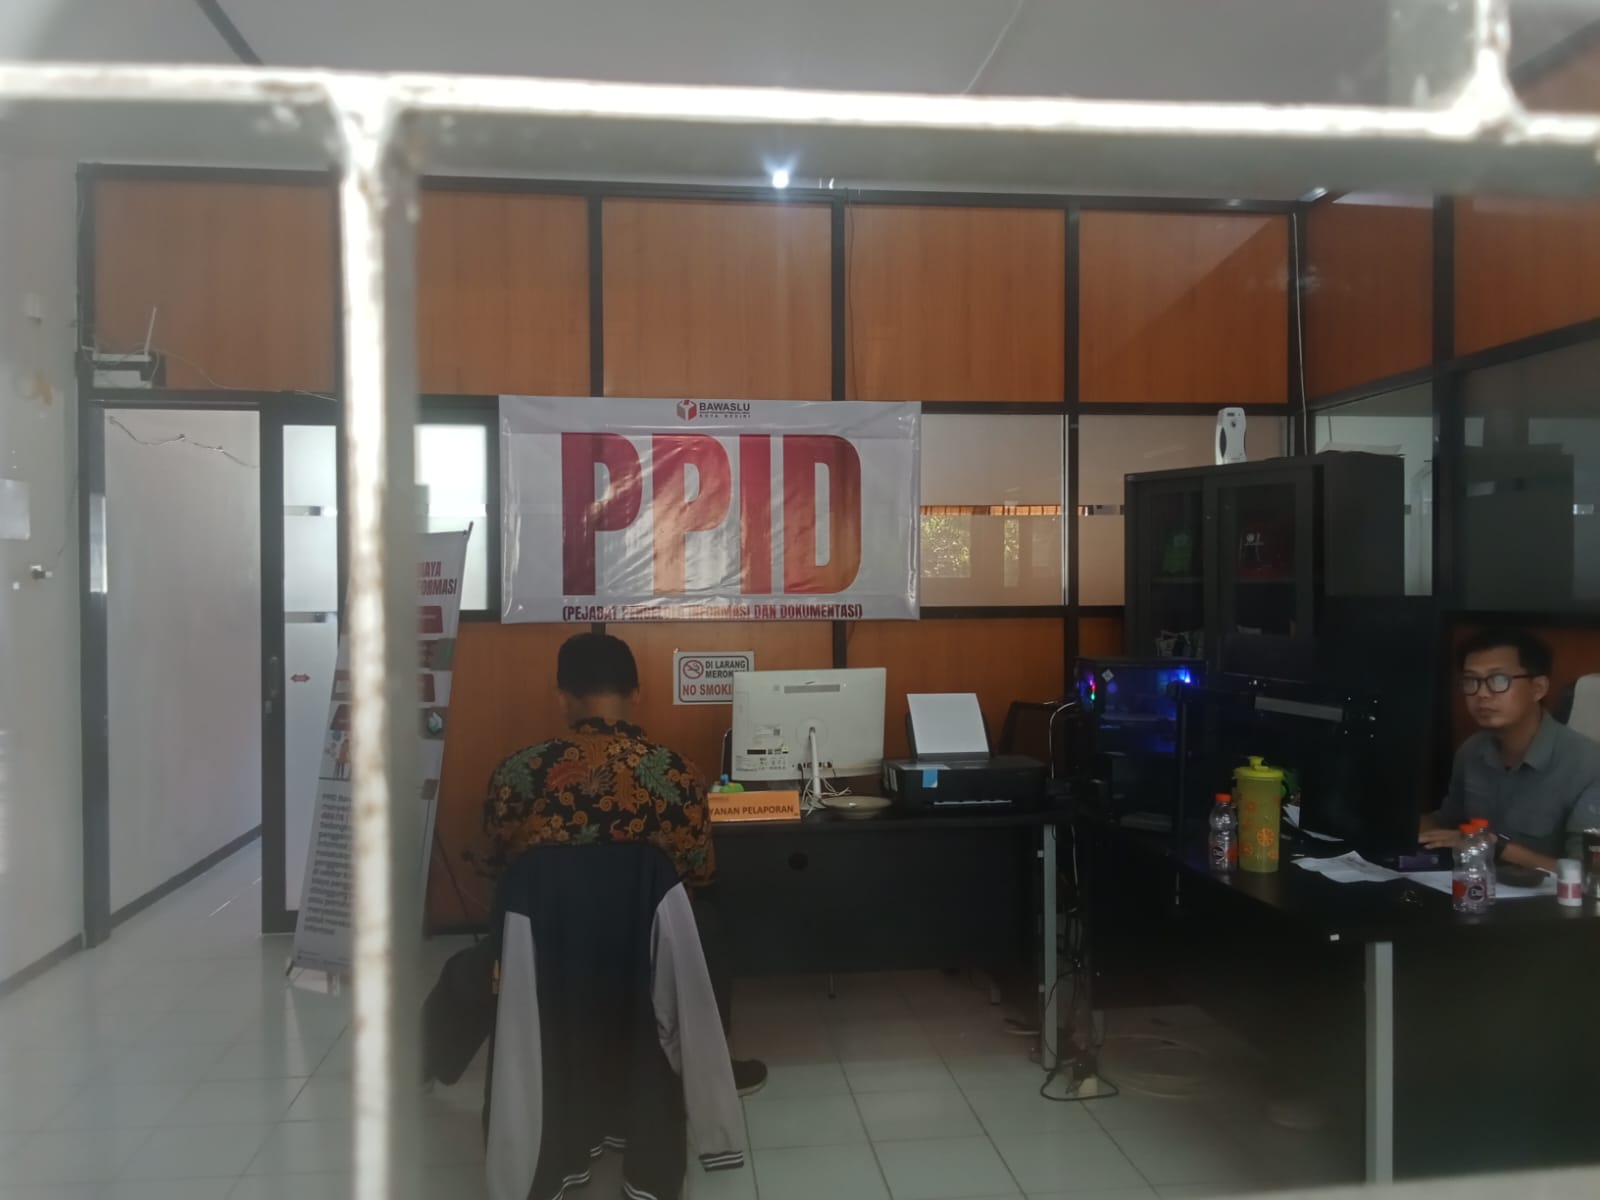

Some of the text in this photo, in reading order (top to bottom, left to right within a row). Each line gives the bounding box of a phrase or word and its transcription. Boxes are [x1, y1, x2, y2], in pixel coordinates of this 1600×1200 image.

[699, 402, 751, 412] BAWASLU
[561, 431, 862, 596] PPID
[754, 604, 776, 619] DAN
[780, 603, 863, 619] DOKUMENTASI)
[705, 660, 746, 669] DI LARANG
[705, 670, 735, 678] MEROK
[682, 683, 733, 696] NO SMOKI
[710, 805, 794, 816] YANAN PELAPORAN
